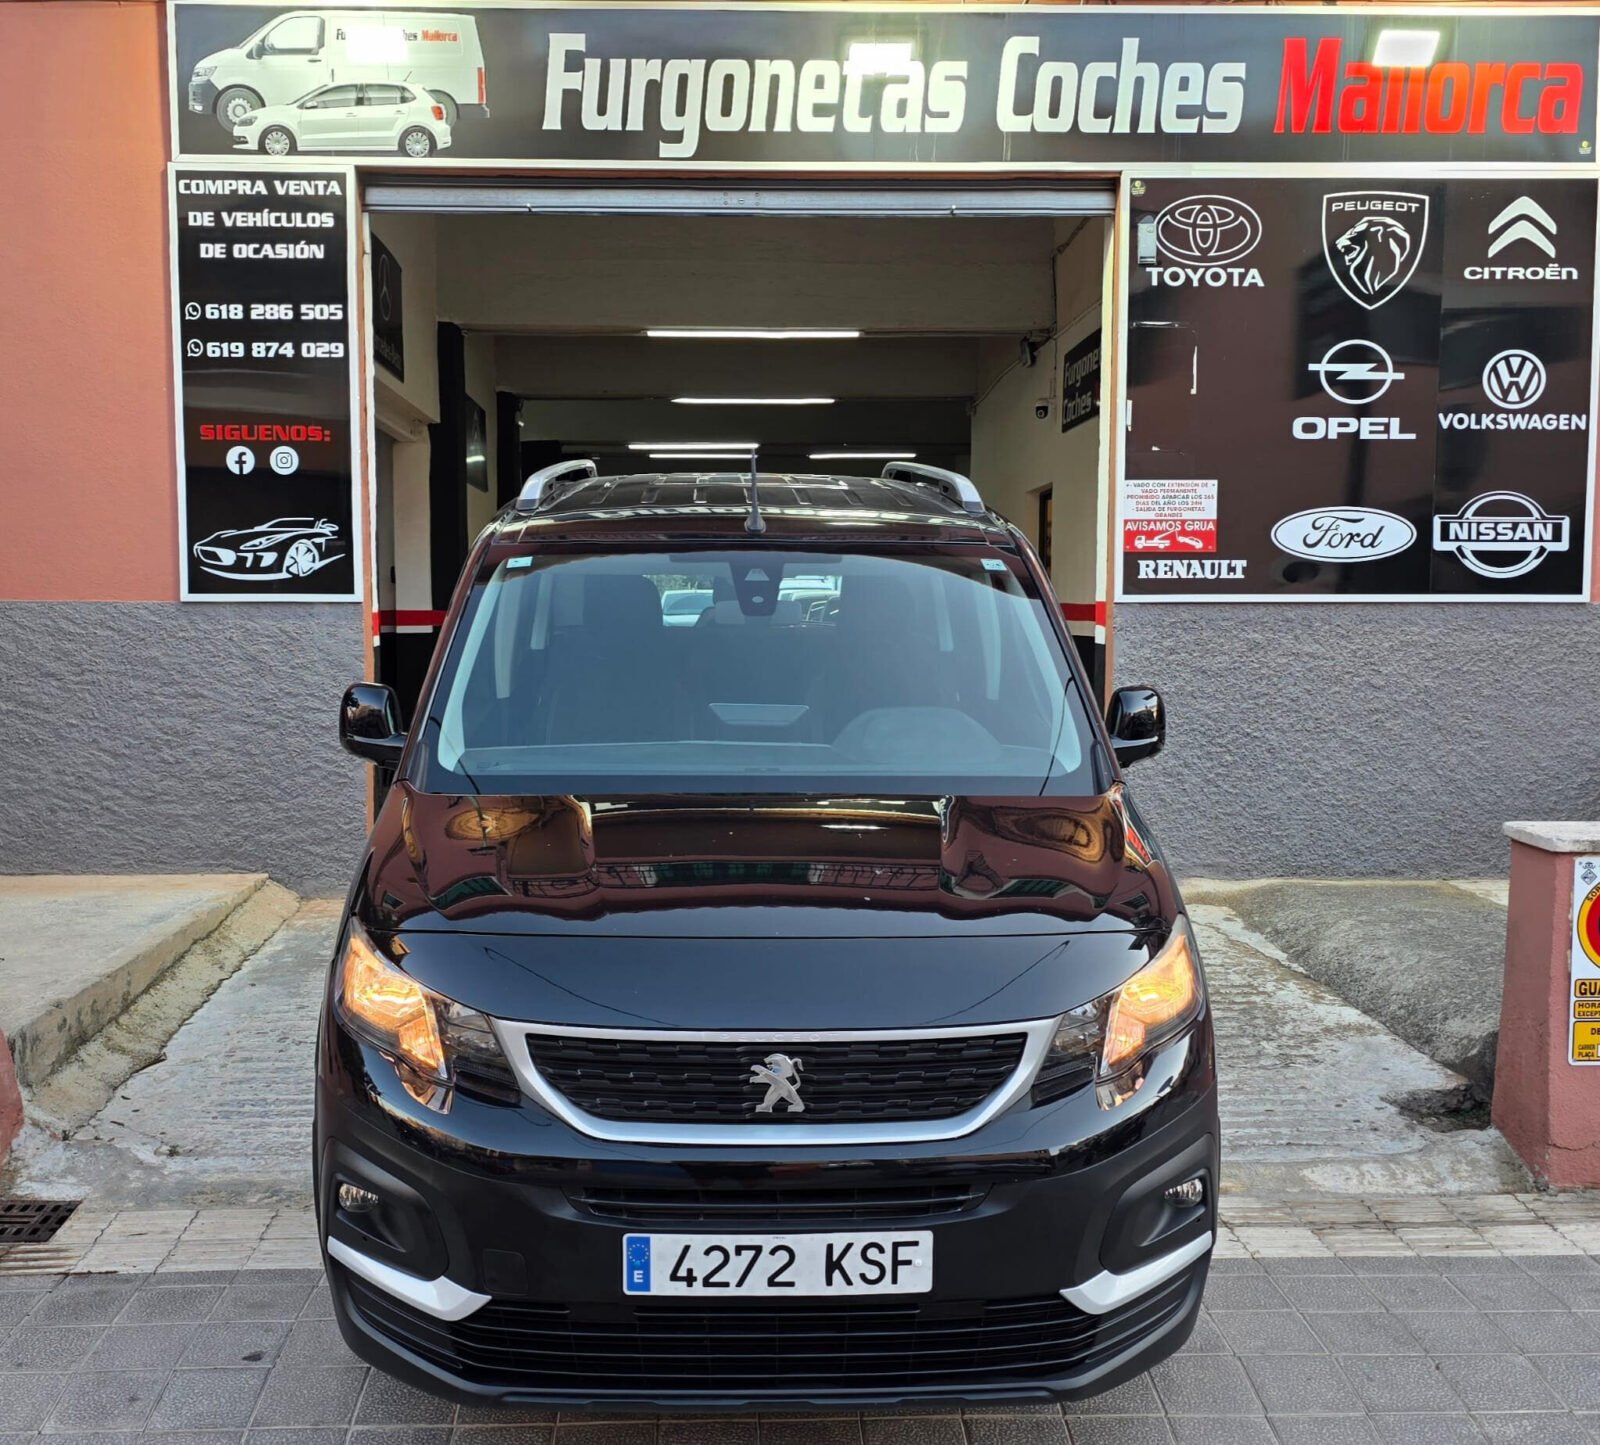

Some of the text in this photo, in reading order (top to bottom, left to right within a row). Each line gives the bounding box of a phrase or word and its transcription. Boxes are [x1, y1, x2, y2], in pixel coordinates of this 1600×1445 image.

[542, 33, 1584, 158] Furgonetas Coches Mallorca
[178, 180, 342, 195] COMPRA VENTA
[1332, 201, 1420, 213] PEUGEOT
[188, 208, 335, 228] DE VEHÍCULOS
[200, 241, 325, 259] DE OCASIÓN
[1146, 267, 1265, 288] TOYOTA
[205, 303, 343, 320] 618 286 505
[206, 342, 345, 358] 619 874 029
[1292, 416, 1417, 440] OPEL
[1438, 413, 1587, 431] VOLKSWAGEN
[200, 424, 331, 442] SIGUENOS:
[1125, 520, 1216, 531] AVISAMOS GRUA
[1302, 514, 1386, 549] Ford
[1449, 522, 1553, 541] NISSAN
[1137, 559, 1248, 579] RENAULT
[669, 1241, 920, 1288] 4272 KSF
[633, 1270, 644, 1283] E
